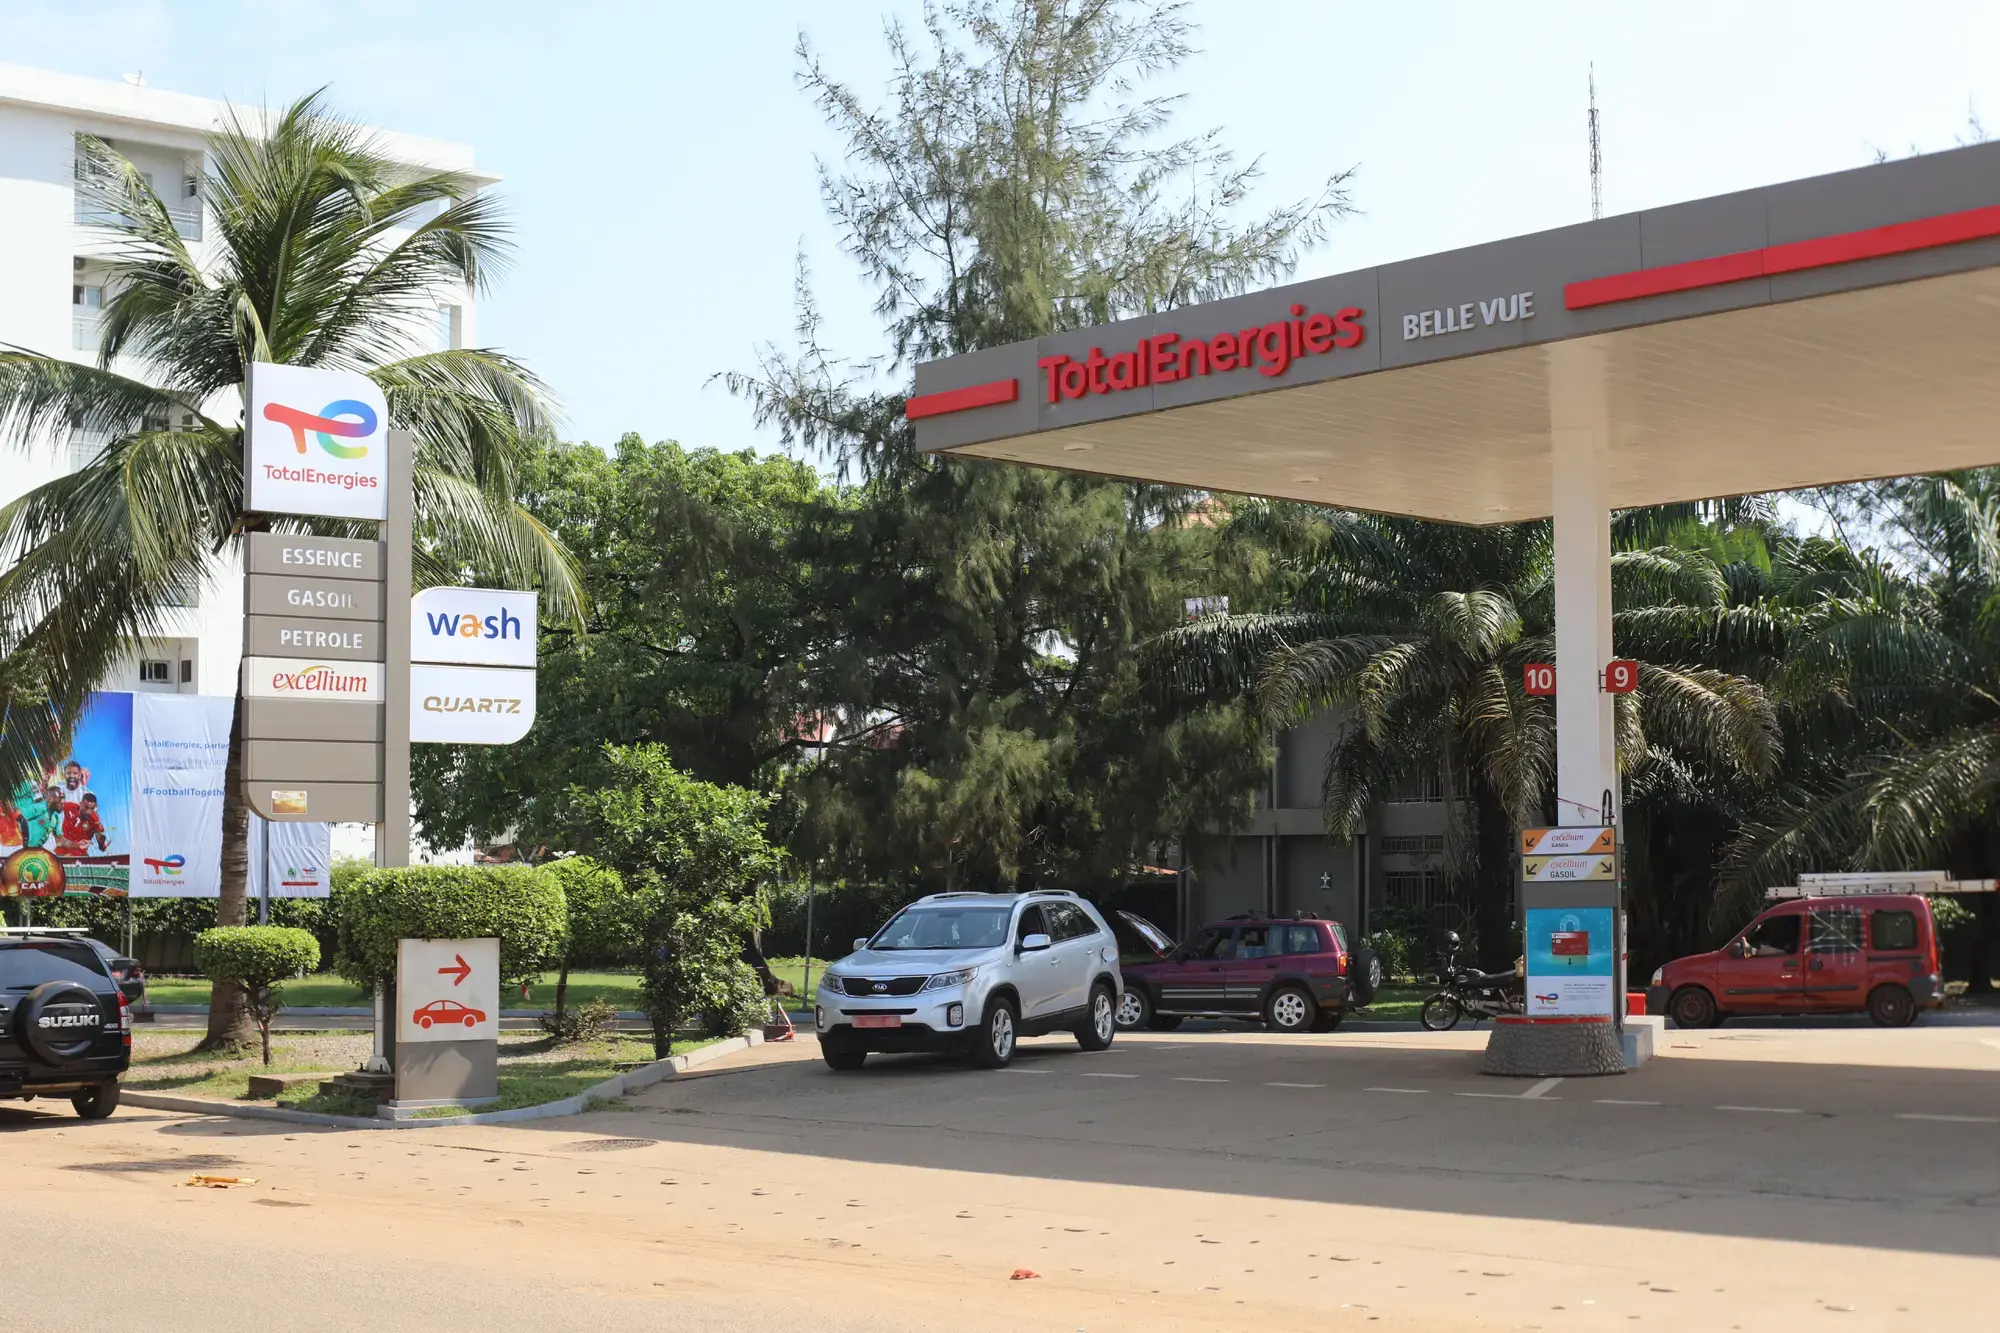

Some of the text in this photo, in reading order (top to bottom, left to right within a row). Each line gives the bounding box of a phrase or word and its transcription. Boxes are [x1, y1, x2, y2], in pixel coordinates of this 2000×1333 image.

[1403, 291, 1535, 340] BELLE VUE
[1037, 303, 1364, 404] TotalEnergies
[263, 464, 378, 490] TotalEnergies
[282, 547, 363, 569] ESSENCE
[287, 589, 357, 608] GASOIL
[426, 606, 521, 640] wash
[280, 629, 363, 649] PETROLE
[272, 668, 367, 693] excellium
[1527, 668, 1552, 690] 10
[1614, 666, 1629, 688] 9
[423, 695, 522, 714] QUARTZ
[144, 740, 203, 750] TotalEnergies,
[1551, 833, 1584, 842] excellium
[1550, 860, 1588, 869] excellium
[1550, 870, 1577, 879] GASOIL
[143, 878, 185, 886] TotalEnergies
[38, 1014, 100, 1029] SUZUKI
